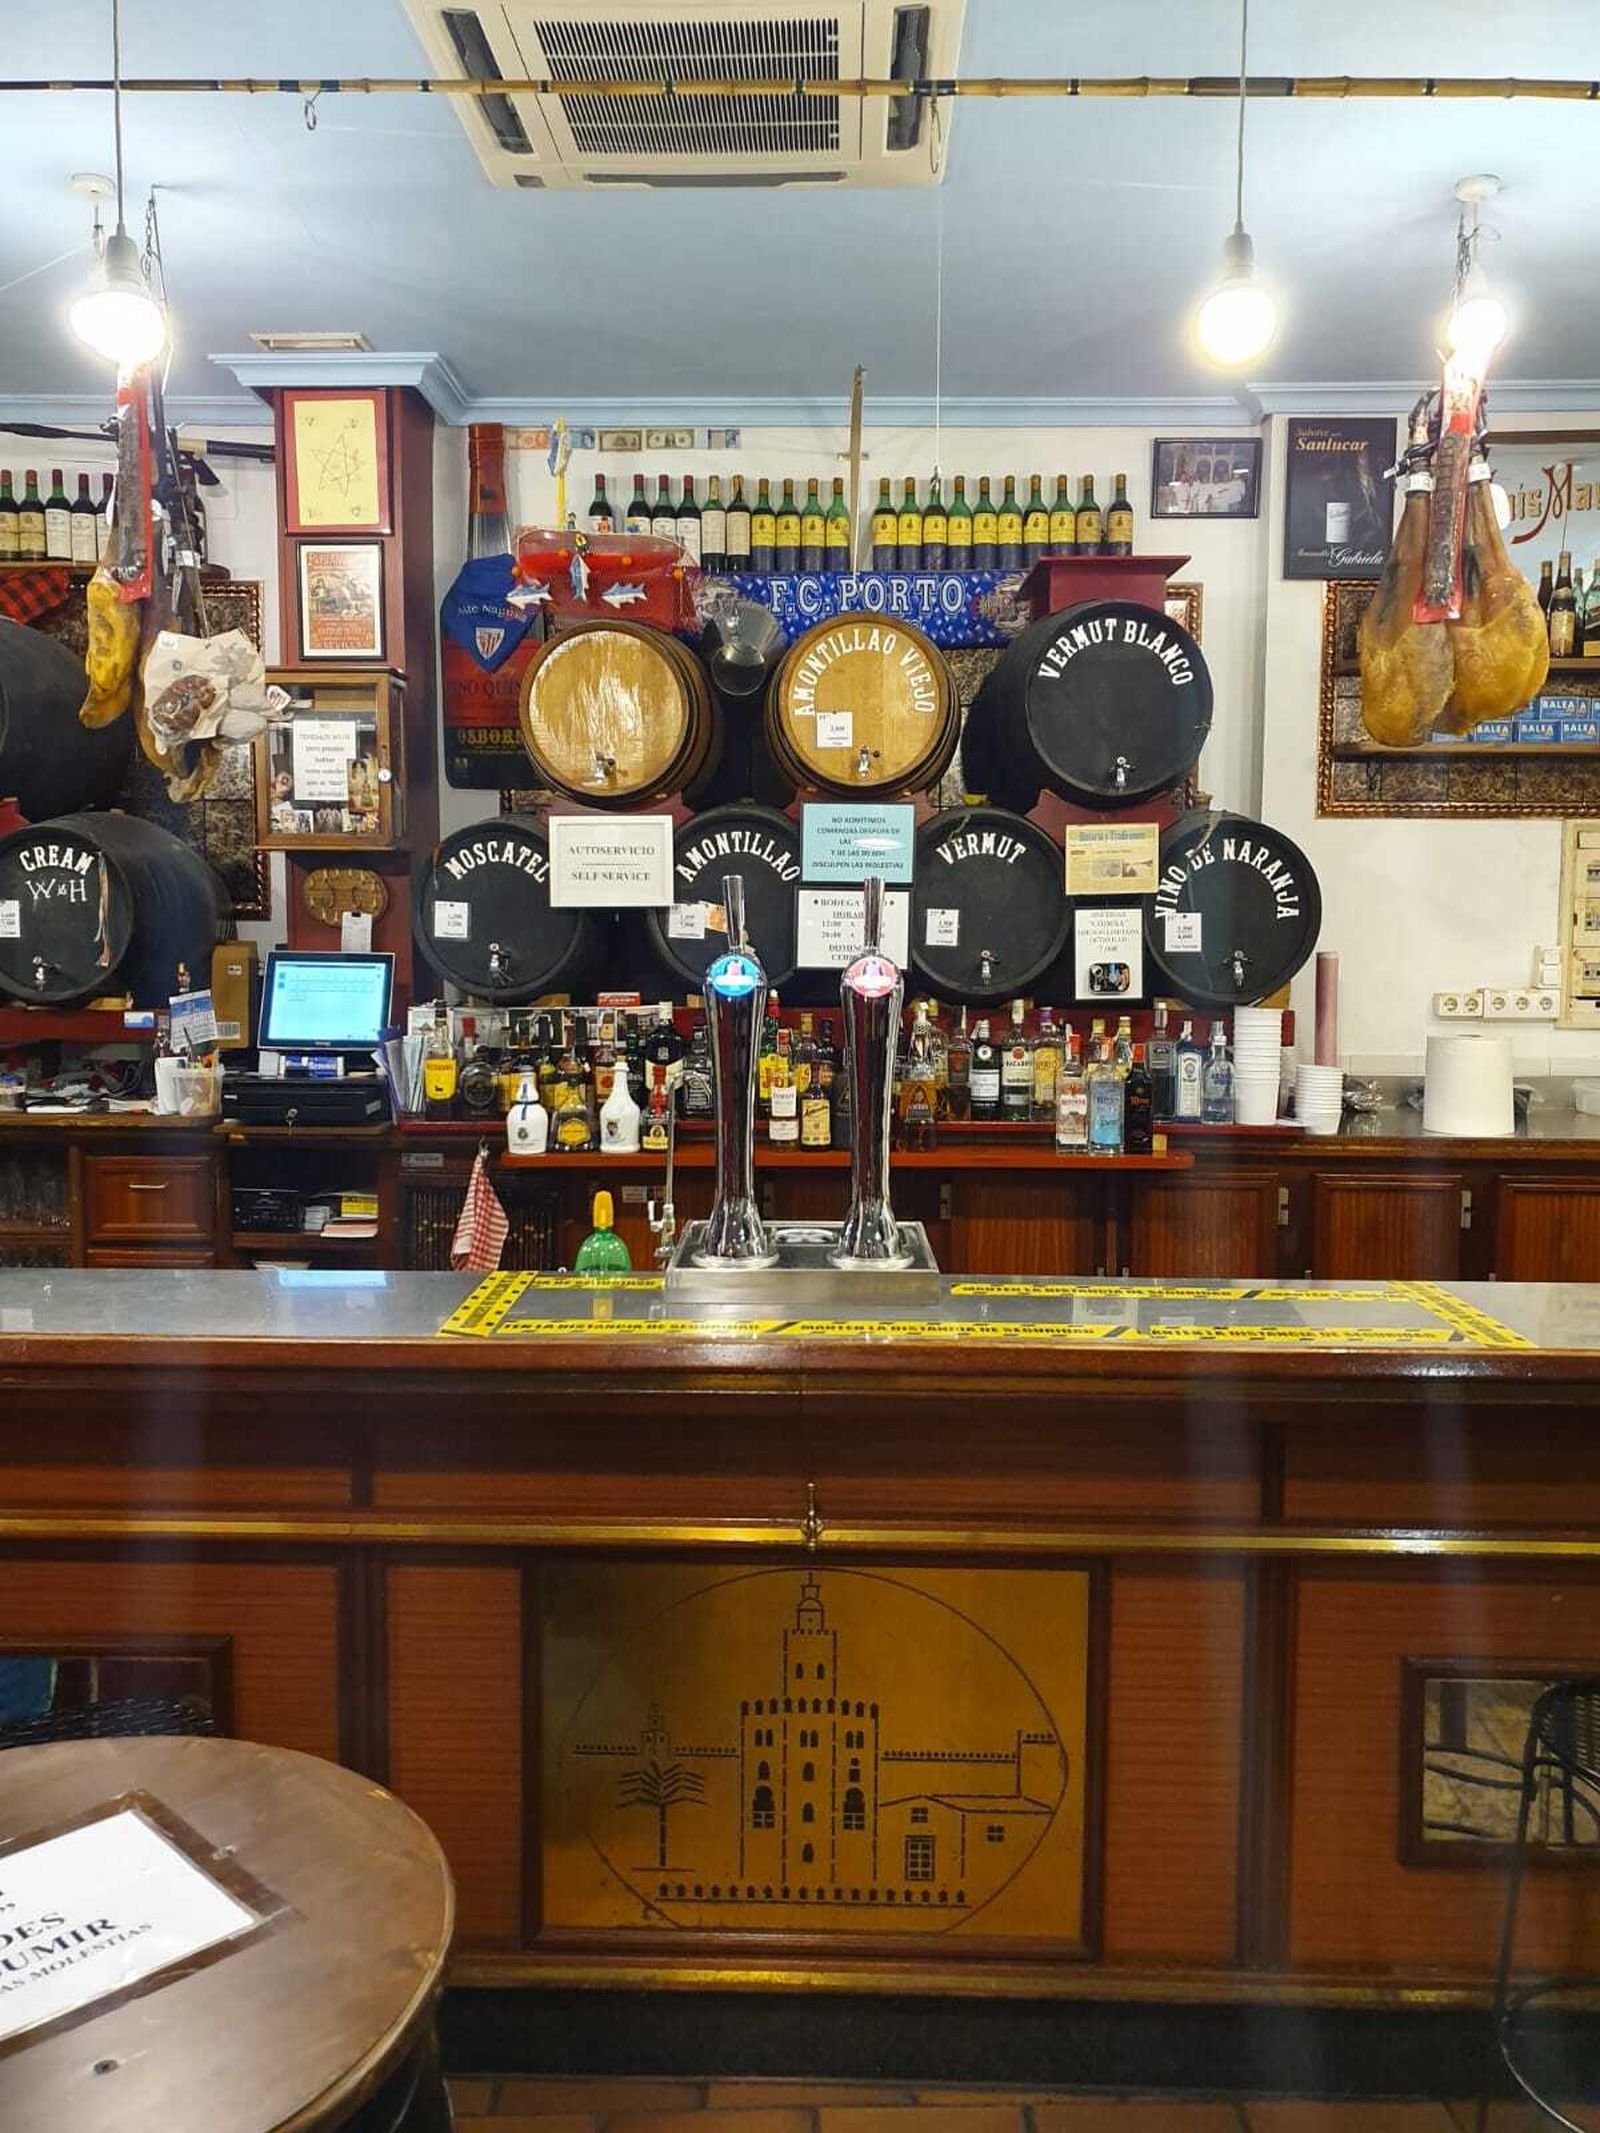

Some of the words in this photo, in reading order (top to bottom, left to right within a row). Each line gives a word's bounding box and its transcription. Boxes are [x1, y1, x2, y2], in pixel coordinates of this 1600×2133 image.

[1296, 437, 1369, 454] Sanlucar
[1328, 547, 1384, 568] Gabriela
[769, 576, 832, 615] F.C.
[837, 576, 966, 617] PORTO
[1037, 617, 1118, 680] VERMUT
[1123, 618, 1196, 687] BLANCO
[793, 628, 898, 717] AMONTILLAO
[900, 646, 937, 714] VIEJO
[1522, 724, 1554, 737] BALEA
[1564, 723, 1597, 737] BALEA
[19, 844, 95, 876] CREAM
[444, 841, 550, 883] MOSCATEL
[569, 846, 656, 855] AUTOSERVICIO
[676, 831, 801, 883] AMONTILLAO
[936, 832, 1027, 864] VERMUT
[572, 872, 599, 881] SELF
[602, 872, 651, 881] SERVICE
[1155, 865, 1187, 918] VINO
[1185, 843, 1216, 871] DE
[1222, 838, 1301, 920] NARANJA
[820, 898, 861, 907] BODEGA
[30, 1923, 152, 1979] MOLESTIAS
